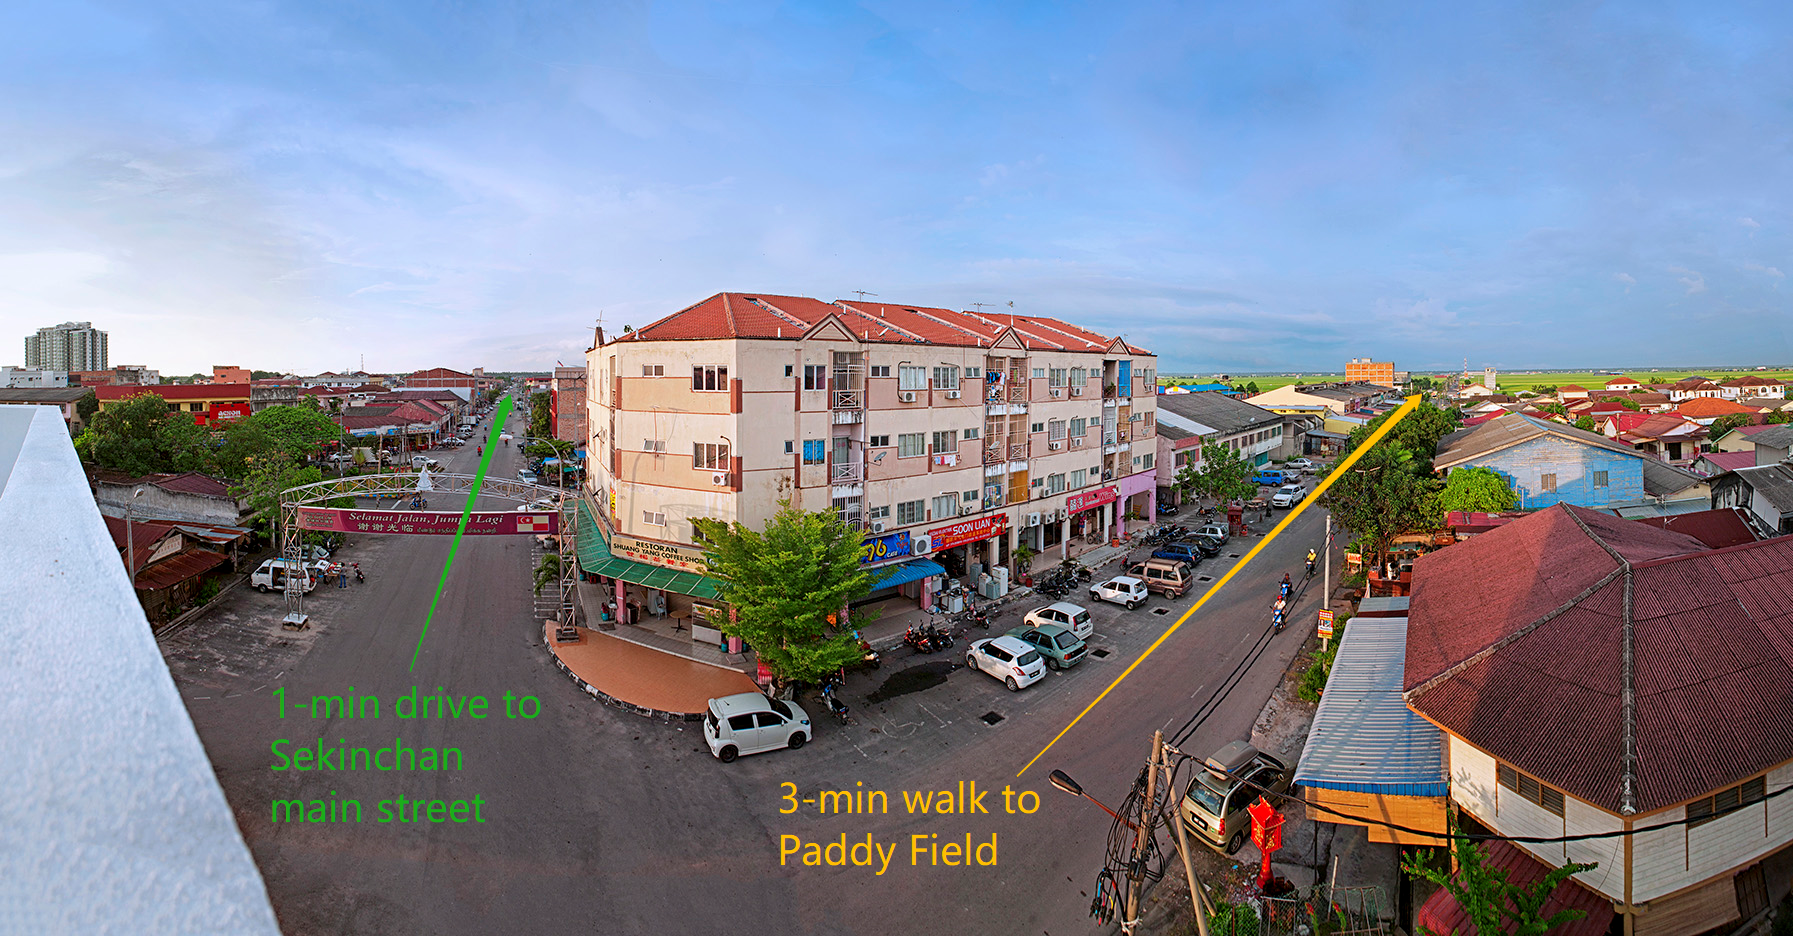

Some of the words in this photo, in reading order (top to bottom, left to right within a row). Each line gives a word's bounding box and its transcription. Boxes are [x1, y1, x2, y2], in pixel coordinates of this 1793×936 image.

[349, 511, 394, 522] Selamat
[395, 513, 431, 524] Jalan,
[475, 515, 504, 525] Lagi
[357, 522, 414, 533] 谢谢光临
[952, 522, 974, 536] SOON
[613, 542, 640, 553] SHUANG
[641, 548, 660, 557] YANG
[661, 552, 684, 562] COFFEE
[635, 541, 678, 554] RESTORAN
